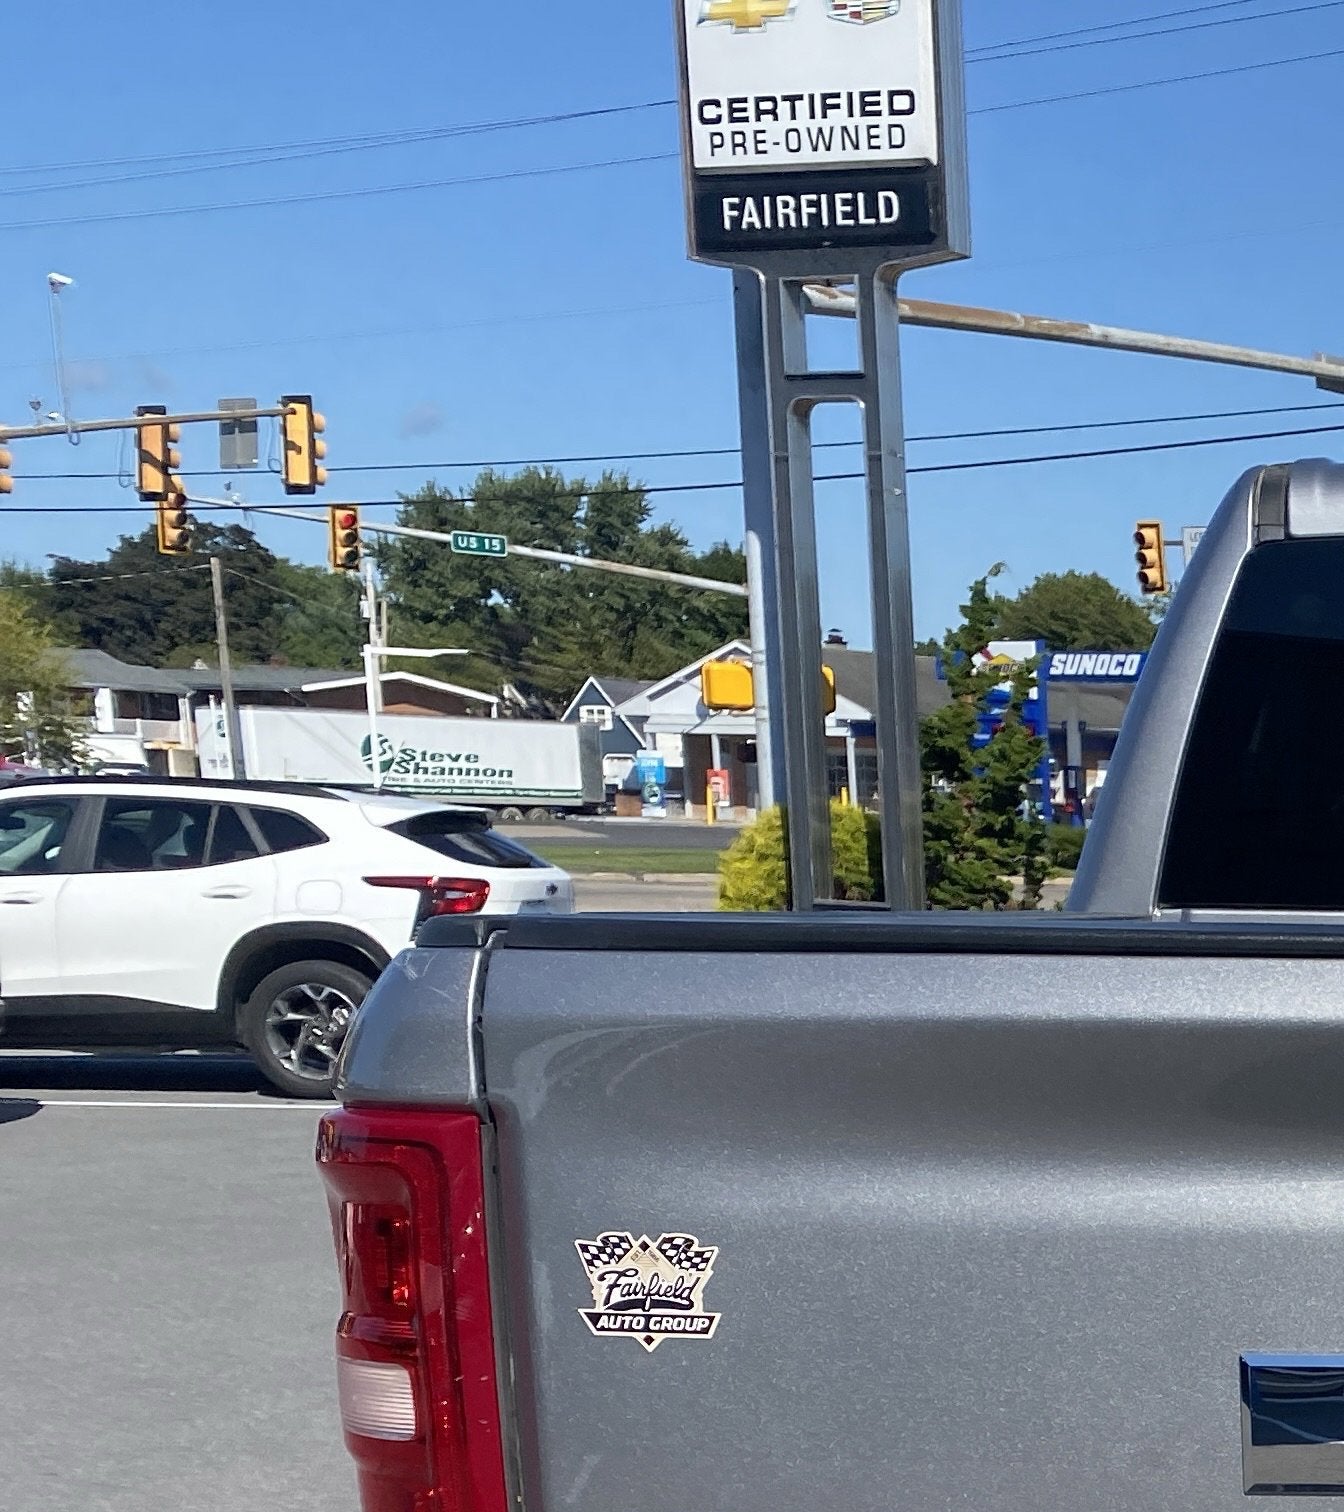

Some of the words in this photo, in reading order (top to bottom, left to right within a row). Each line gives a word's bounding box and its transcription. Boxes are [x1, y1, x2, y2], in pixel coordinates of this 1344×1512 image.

[698, 89, 916, 125] CERTIFIED
[709, 124, 906, 157] PRE-OWNED
[722, 190, 900, 231] FAIRFIELD
[457, 535, 477, 549] US
[484, 538, 501, 551] 15
[1049, 653, 1142, 676] SUNOCO
[399, 747, 480, 763] Steve
[392, 758, 514, 778] Shannon
[597, 1268, 702, 1311] Fairfield
[596, 1315, 645, 1331] AUTO
[649, 1316, 711, 1332] GROUP
